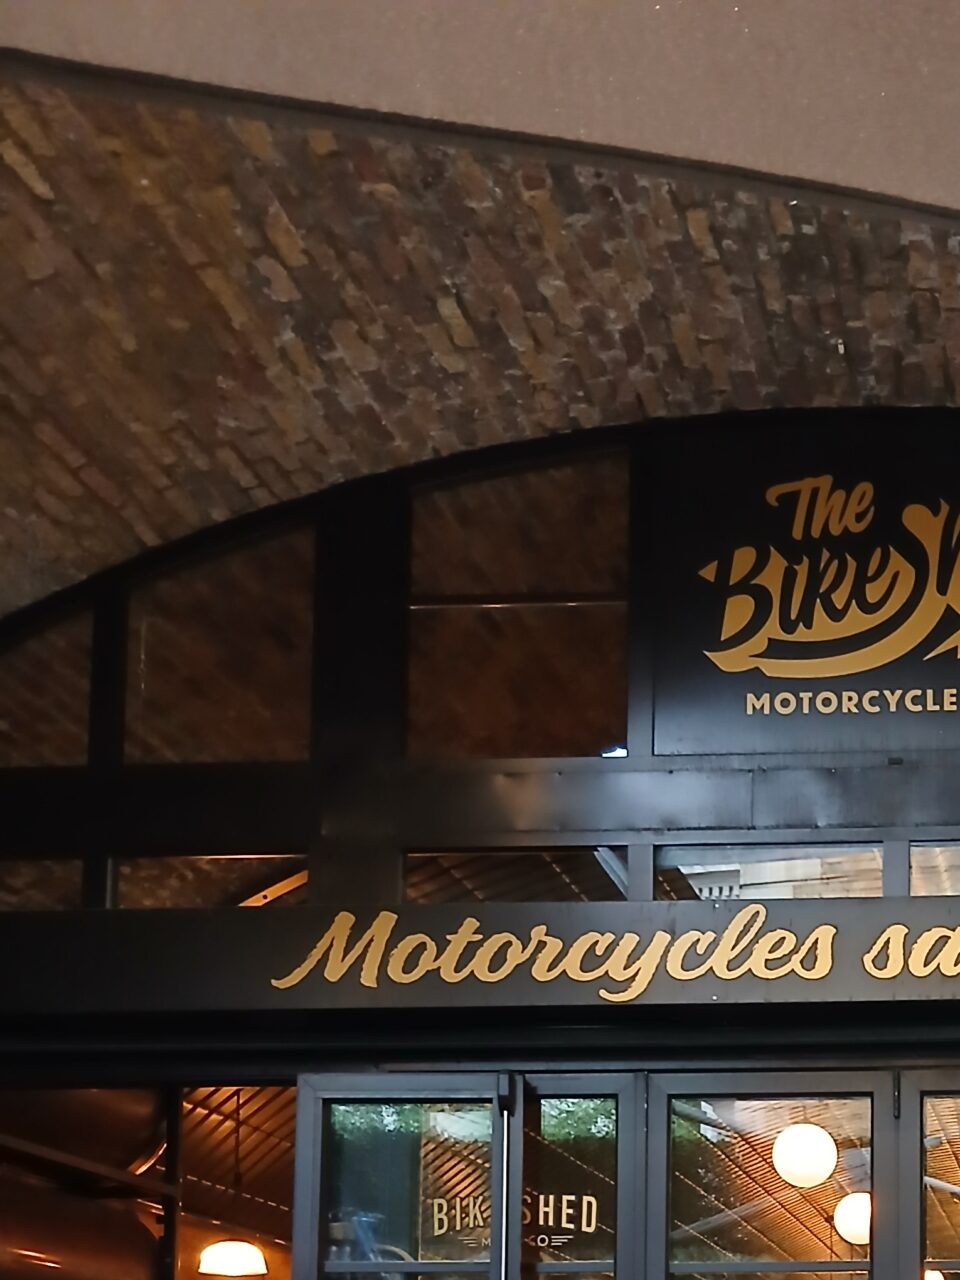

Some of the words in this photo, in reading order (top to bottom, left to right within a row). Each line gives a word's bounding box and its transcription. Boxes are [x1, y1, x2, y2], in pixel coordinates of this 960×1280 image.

[765, 474, 874, 541] The
[746, 689, 957, 715] MOTORCYCLE
[271, 902, 838, 1003] Motorcycles
[433, 1195, 485, 1236] BIK
